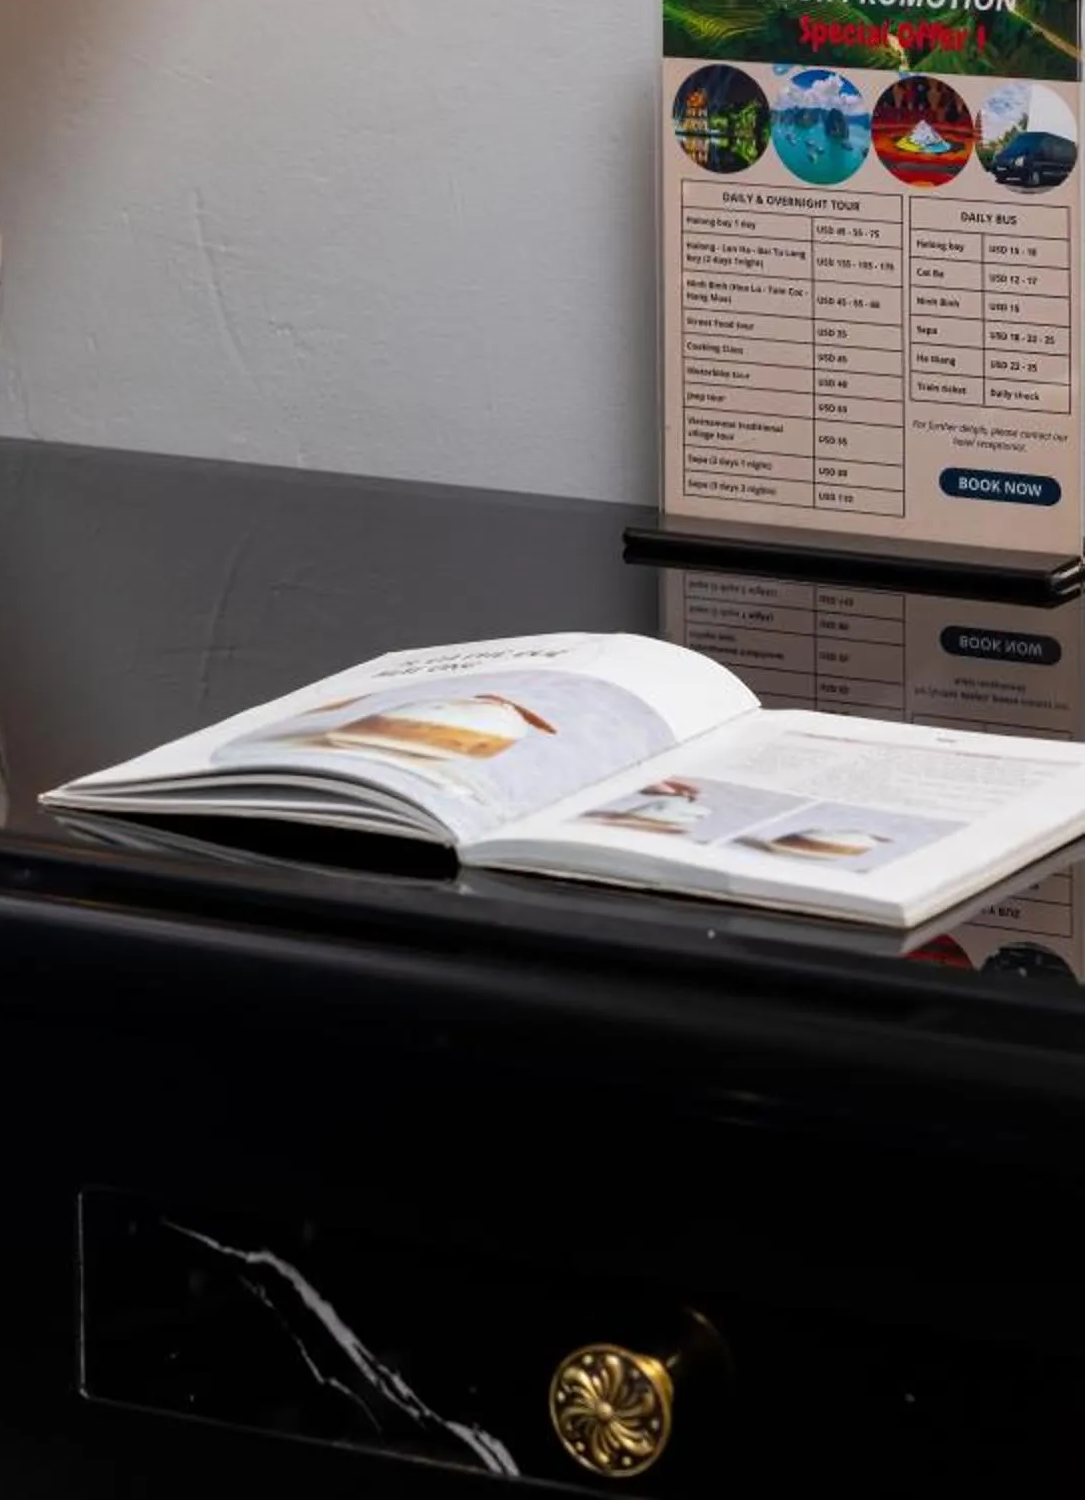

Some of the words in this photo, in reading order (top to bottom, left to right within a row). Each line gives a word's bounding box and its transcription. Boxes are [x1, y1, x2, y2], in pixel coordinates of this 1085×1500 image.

[798, 15, 889, 52] Special
[723, 192, 753, 204] DAILY
[767, 195, 827, 210] OVERNIGHT
[832, 200, 861, 211] TOUR
[961, 212, 993, 224] DAILY
[996, 214, 1017, 226] BUS
[958, 476, 1001, 493] BOOK
[1005, 481, 1043, 497] NOW
